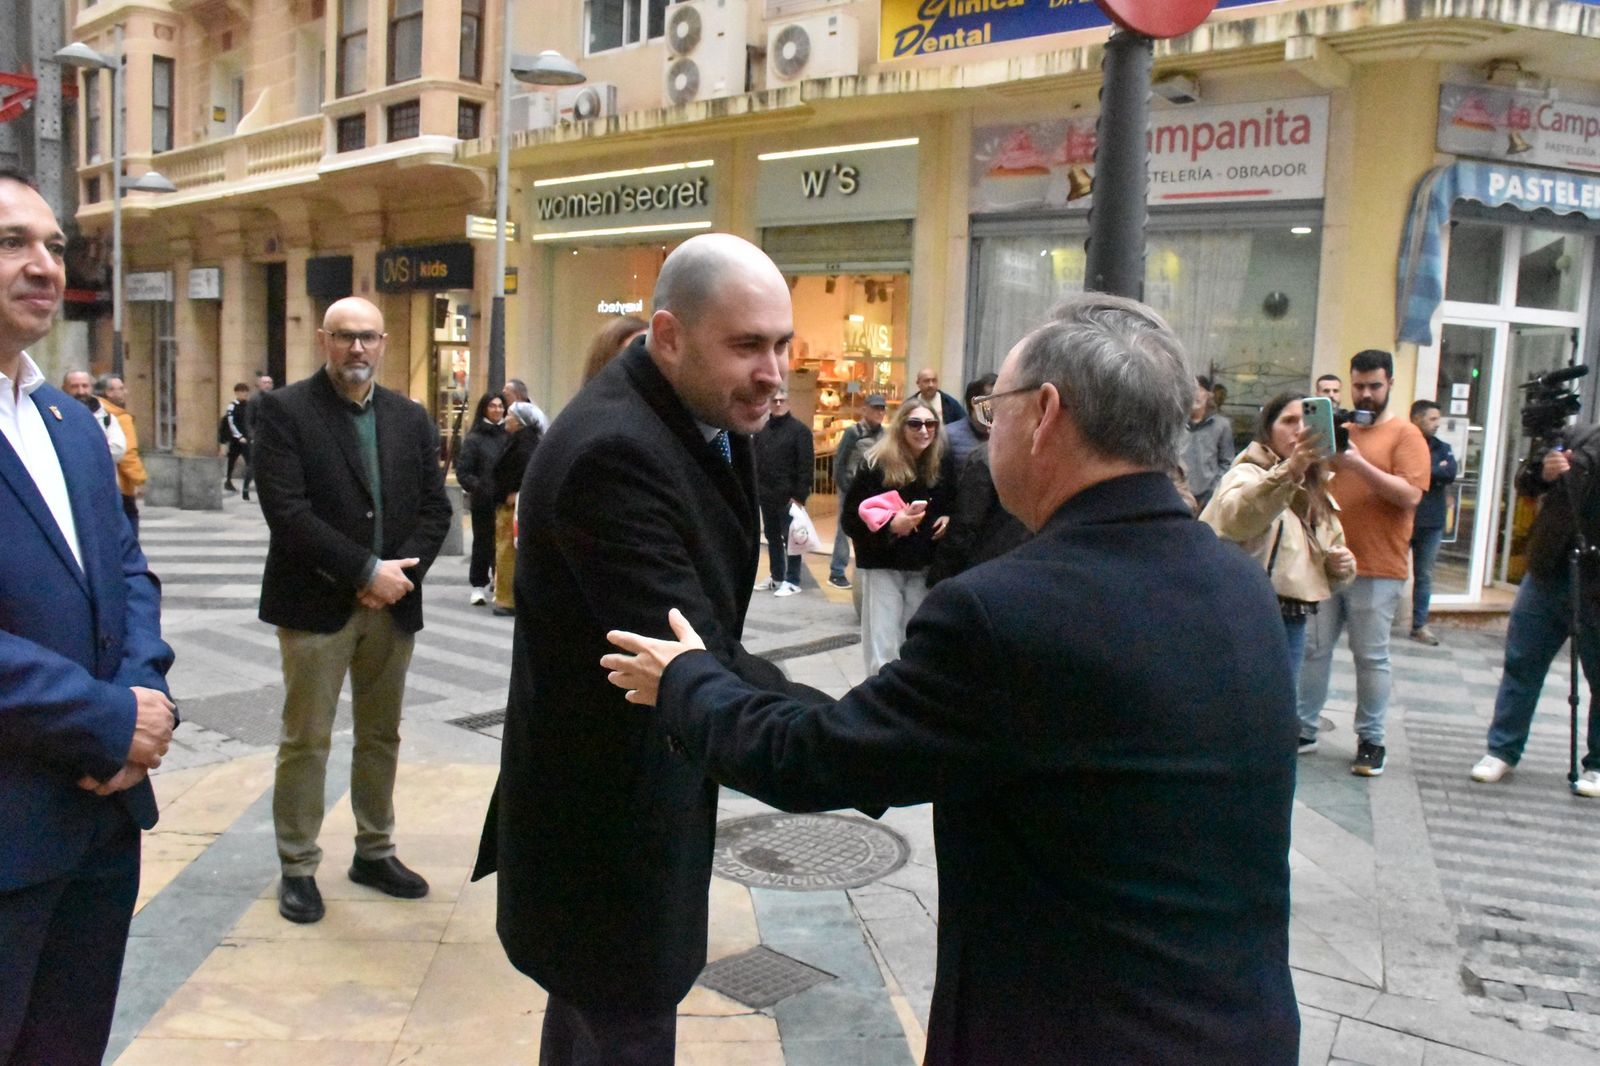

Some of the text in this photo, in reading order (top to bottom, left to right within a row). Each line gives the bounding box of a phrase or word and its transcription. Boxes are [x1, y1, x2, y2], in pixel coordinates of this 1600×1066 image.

[892, 23, 991, 57] Dental
[1146, 107, 1311, 162] mpanita
[1537, 104, 1600, 142] Camp
[1146, 164, 1212, 184] TELERÍA
[1227, 163, 1307, 181] OBRADOR
[537, 176, 707, 220] women'secret
[382, 256, 448, 283] OVS kids
